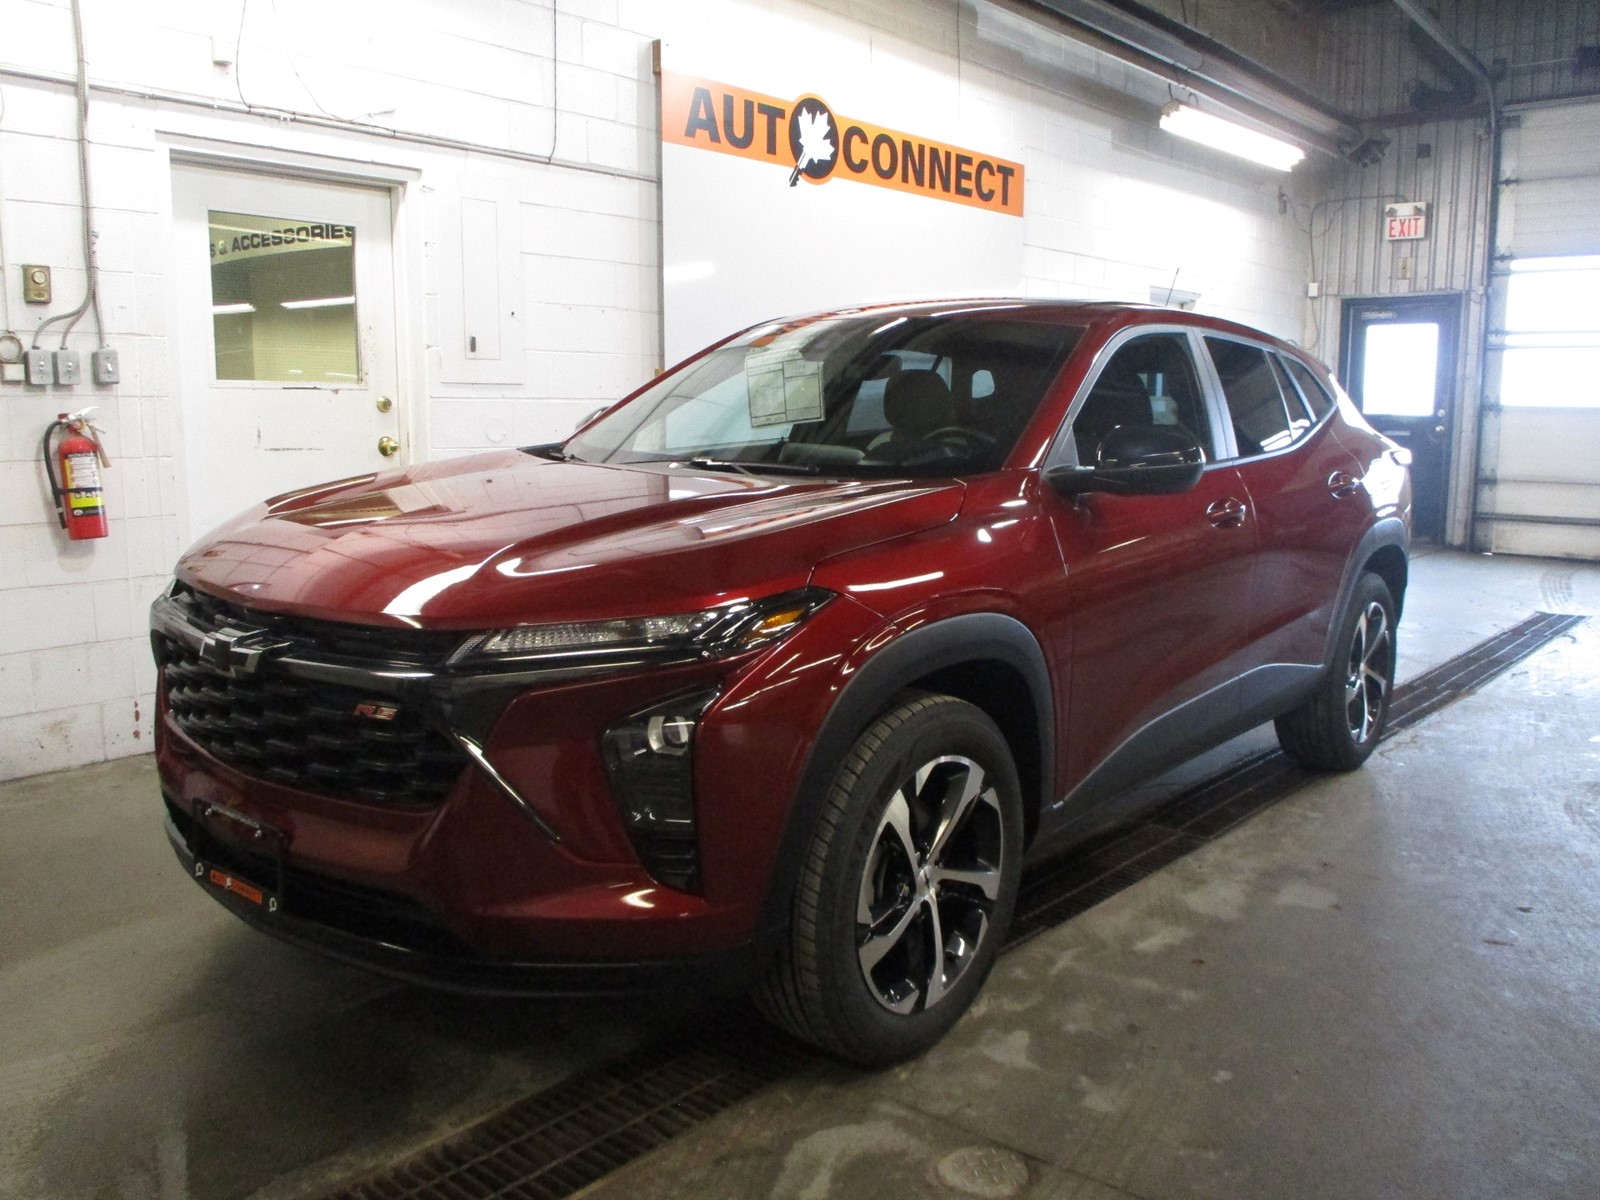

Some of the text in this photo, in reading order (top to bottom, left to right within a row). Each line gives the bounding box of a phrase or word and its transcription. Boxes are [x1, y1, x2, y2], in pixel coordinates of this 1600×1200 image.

[231, 224, 353, 252] ACCESSORIES
[1388, 217, 1421, 238] EXIT
[353, 703, 398, 721] RS
